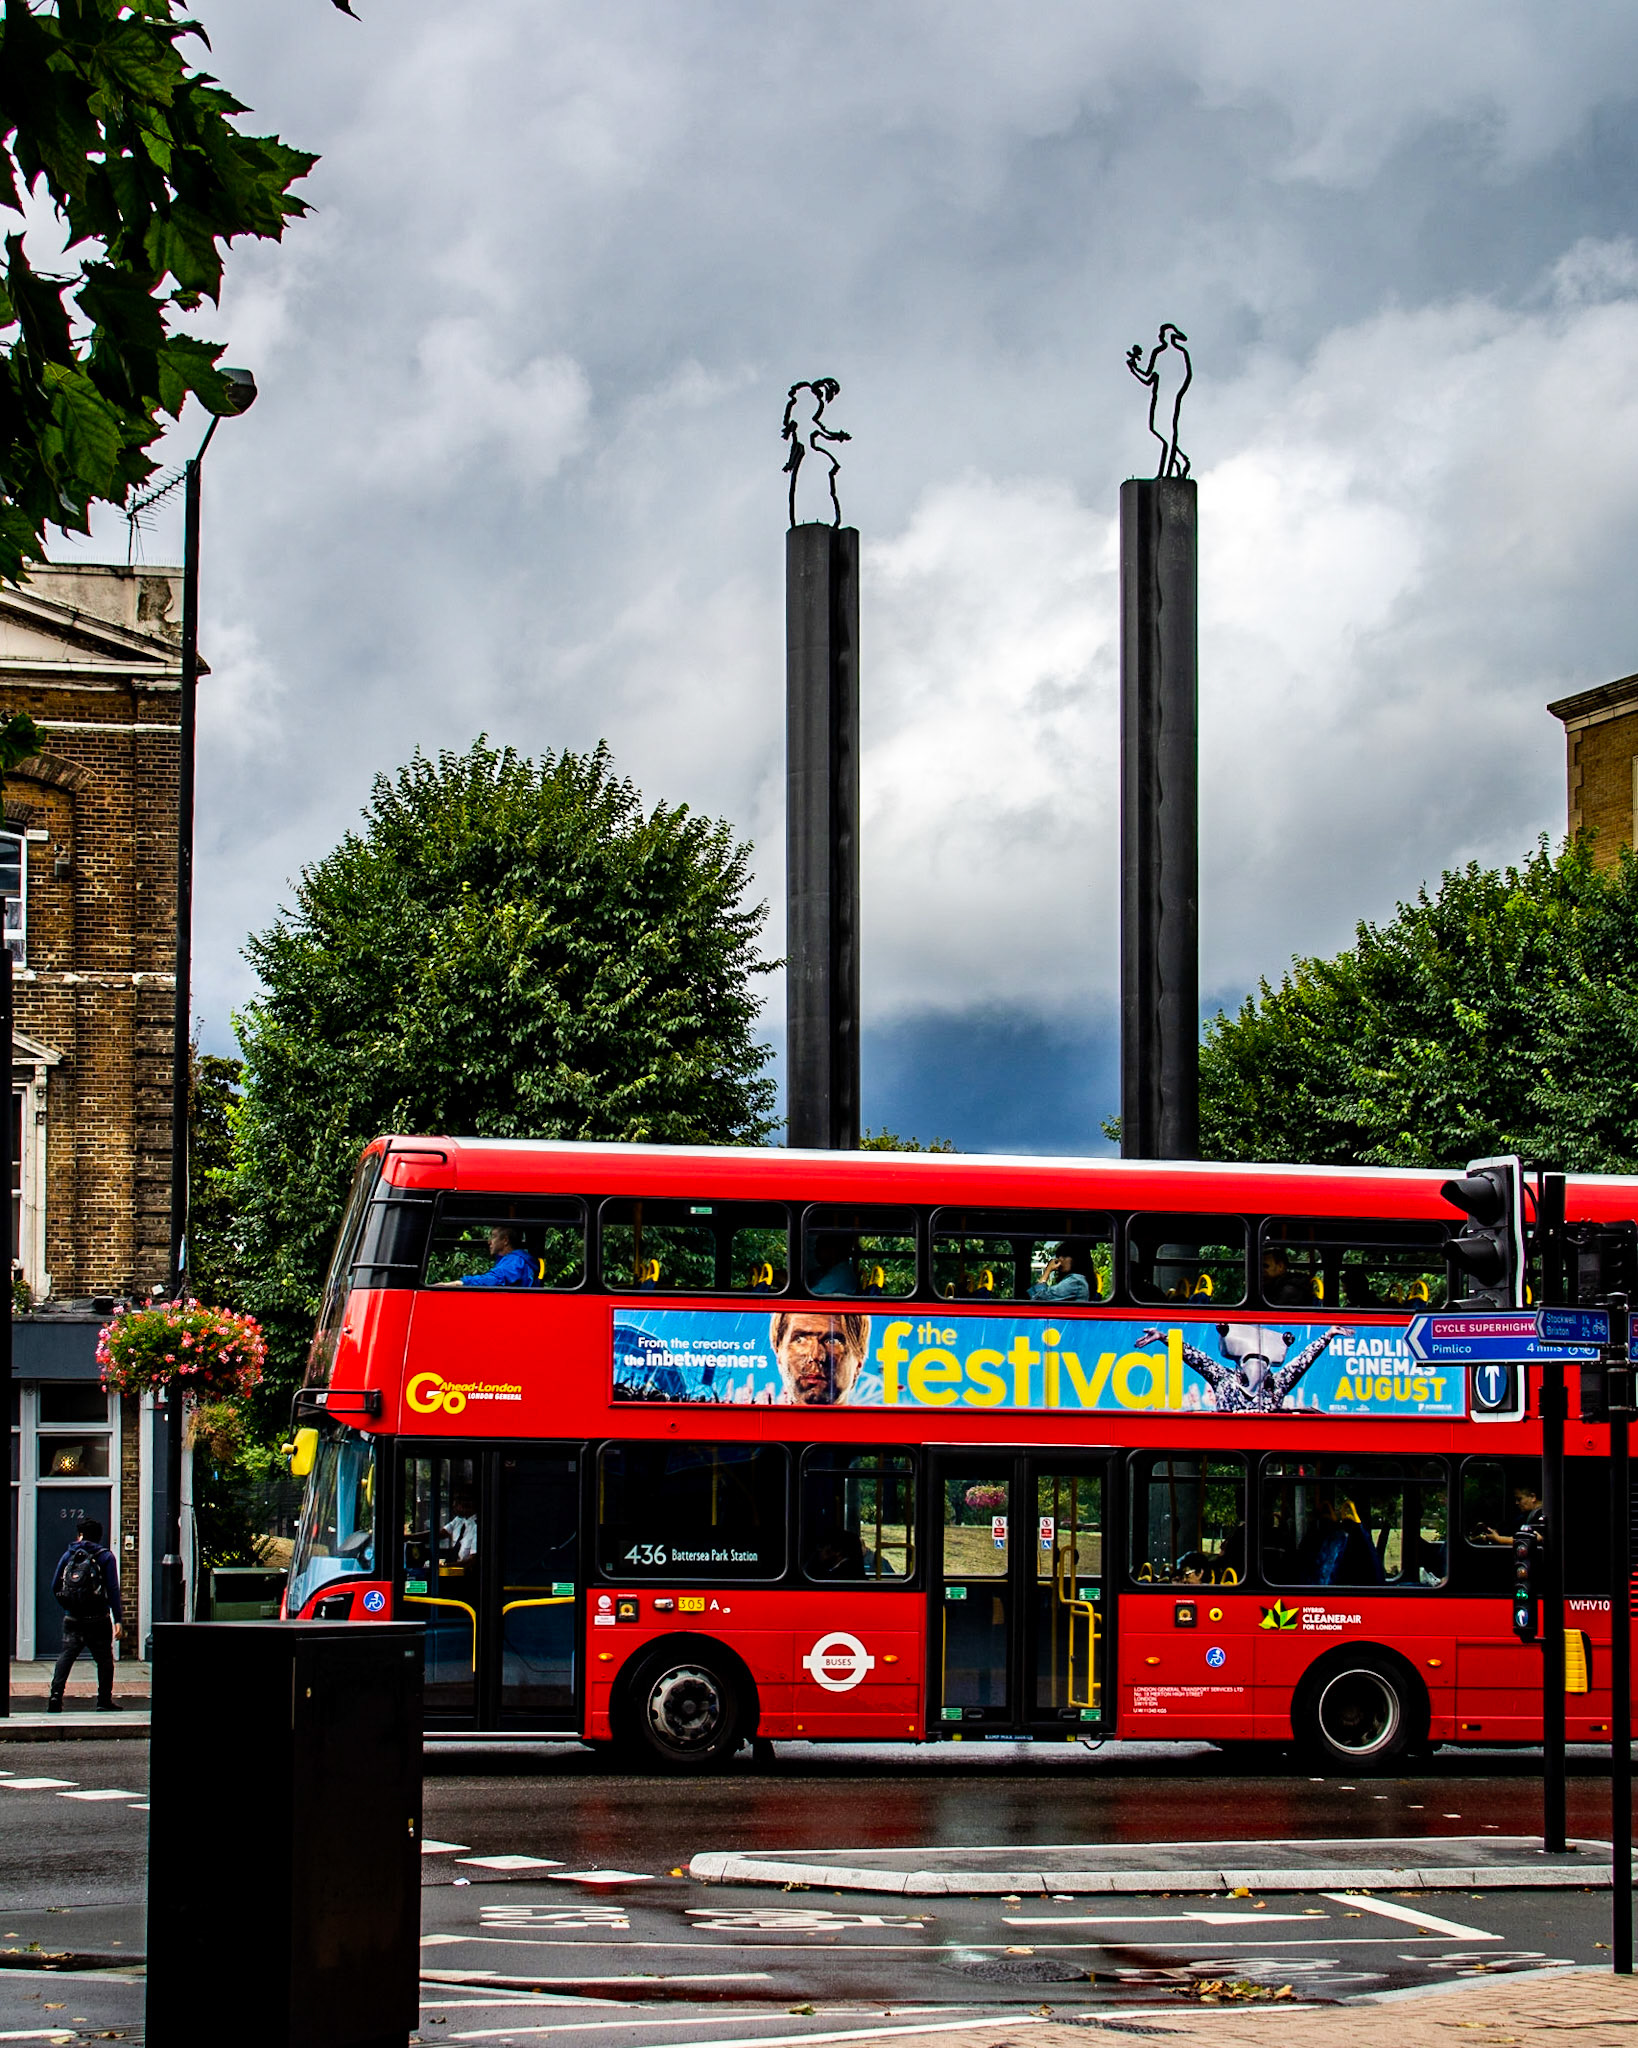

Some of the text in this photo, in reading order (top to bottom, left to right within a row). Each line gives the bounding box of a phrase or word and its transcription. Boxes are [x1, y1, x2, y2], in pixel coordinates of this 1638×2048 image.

[1546, 1312, 1577, 1324] Stockwell
[917, 1321, 958, 1345] the
[1434, 1322, 1536, 1333] CYCLE SUPERHIGHW
[1546, 1325, 1570, 1336] Brixton
[638, 1337, 756, 1350] From the creators of
[1432, 1344, 1472, 1354] Pimlico
[1526, 1342, 1535, 1353] 4
[623, 1350, 768, 1368] the inbetweeners
[876, 1321, 1184, 1410] festival
[405, 1371, 467, 1415] Go
[1334, 1376, 1447, 1402] AUGUST
[467, 1392, 523, 1401] LONDON GENERAL
[60, 1508, 85, 1519] 372
[624, 1544, 758, 1565] 436 Battersea Park Station
[679, 1599, 703, 1609] 305
[709, 1599, 720, 1611] A
[1569, 1600, 1611, 1611] WHV10
[825, 1658, 852, 1666] BUSES
